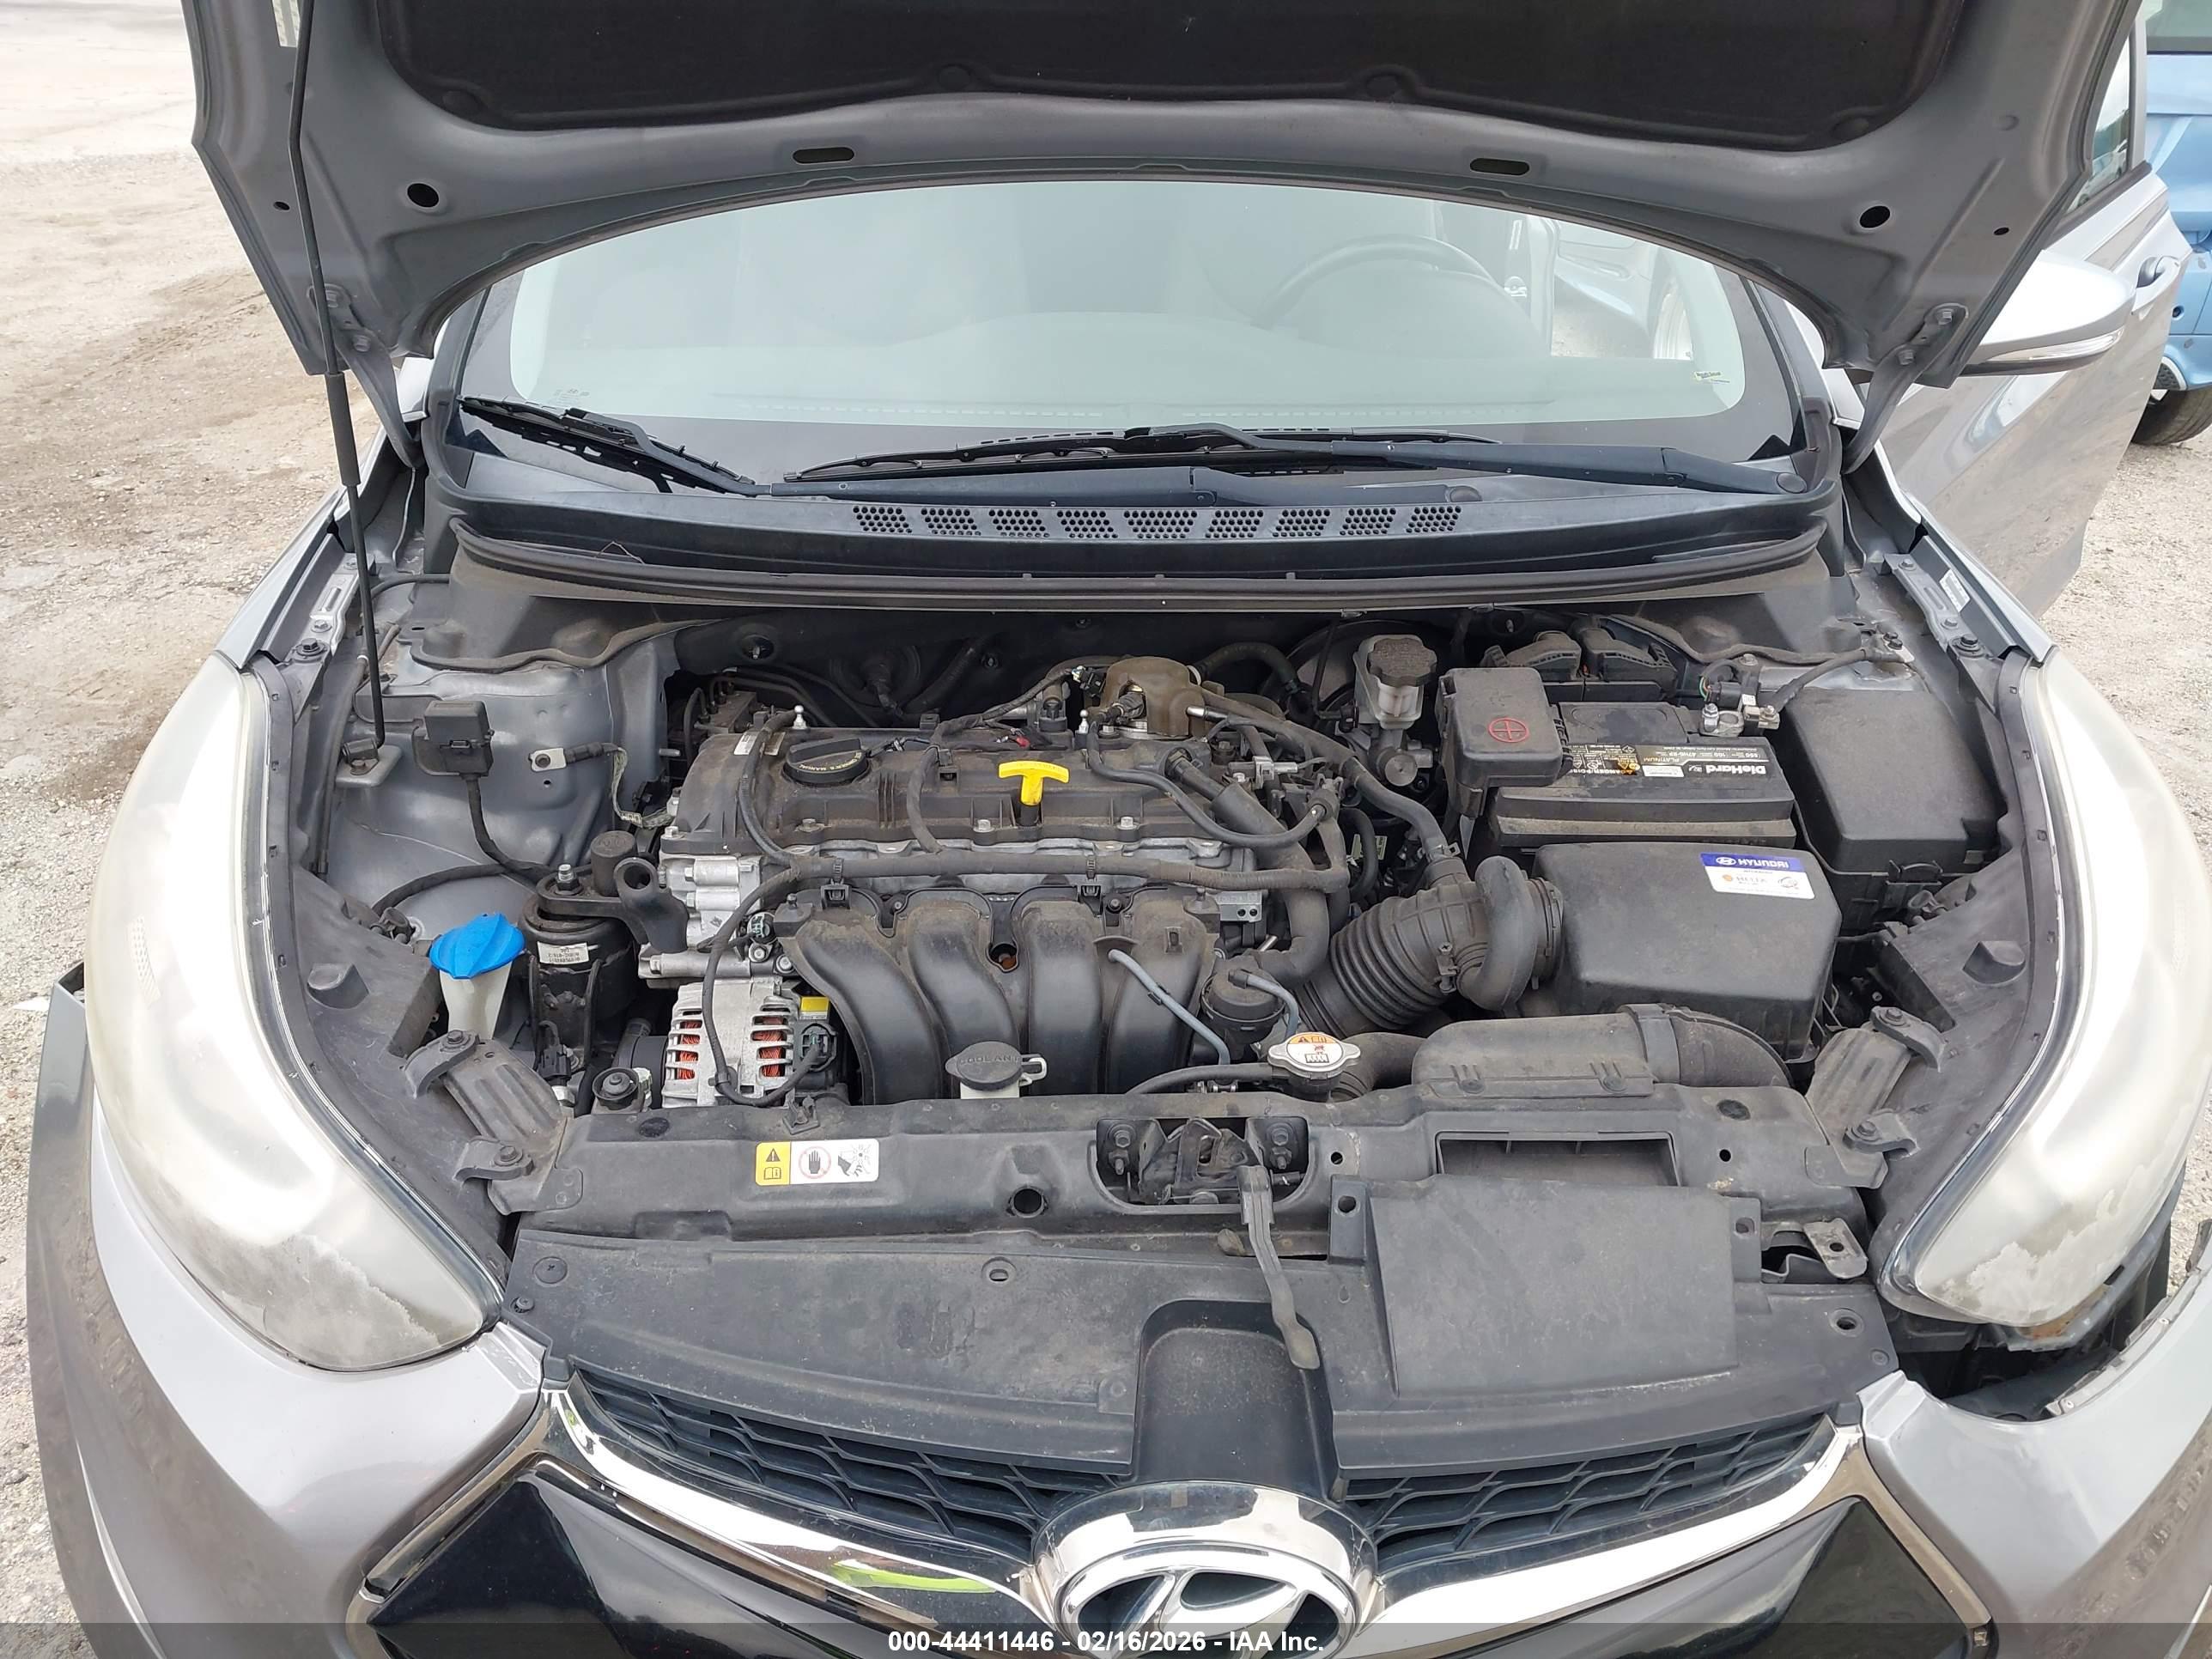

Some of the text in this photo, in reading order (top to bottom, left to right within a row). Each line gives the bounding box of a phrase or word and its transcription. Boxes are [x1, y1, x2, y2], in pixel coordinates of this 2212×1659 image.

[1706, 765, 1766, 775] DieHard
[1738, 859, 1789, 868] HYUNDAI
[960, 1054, 1019, 1065] COOLANT
